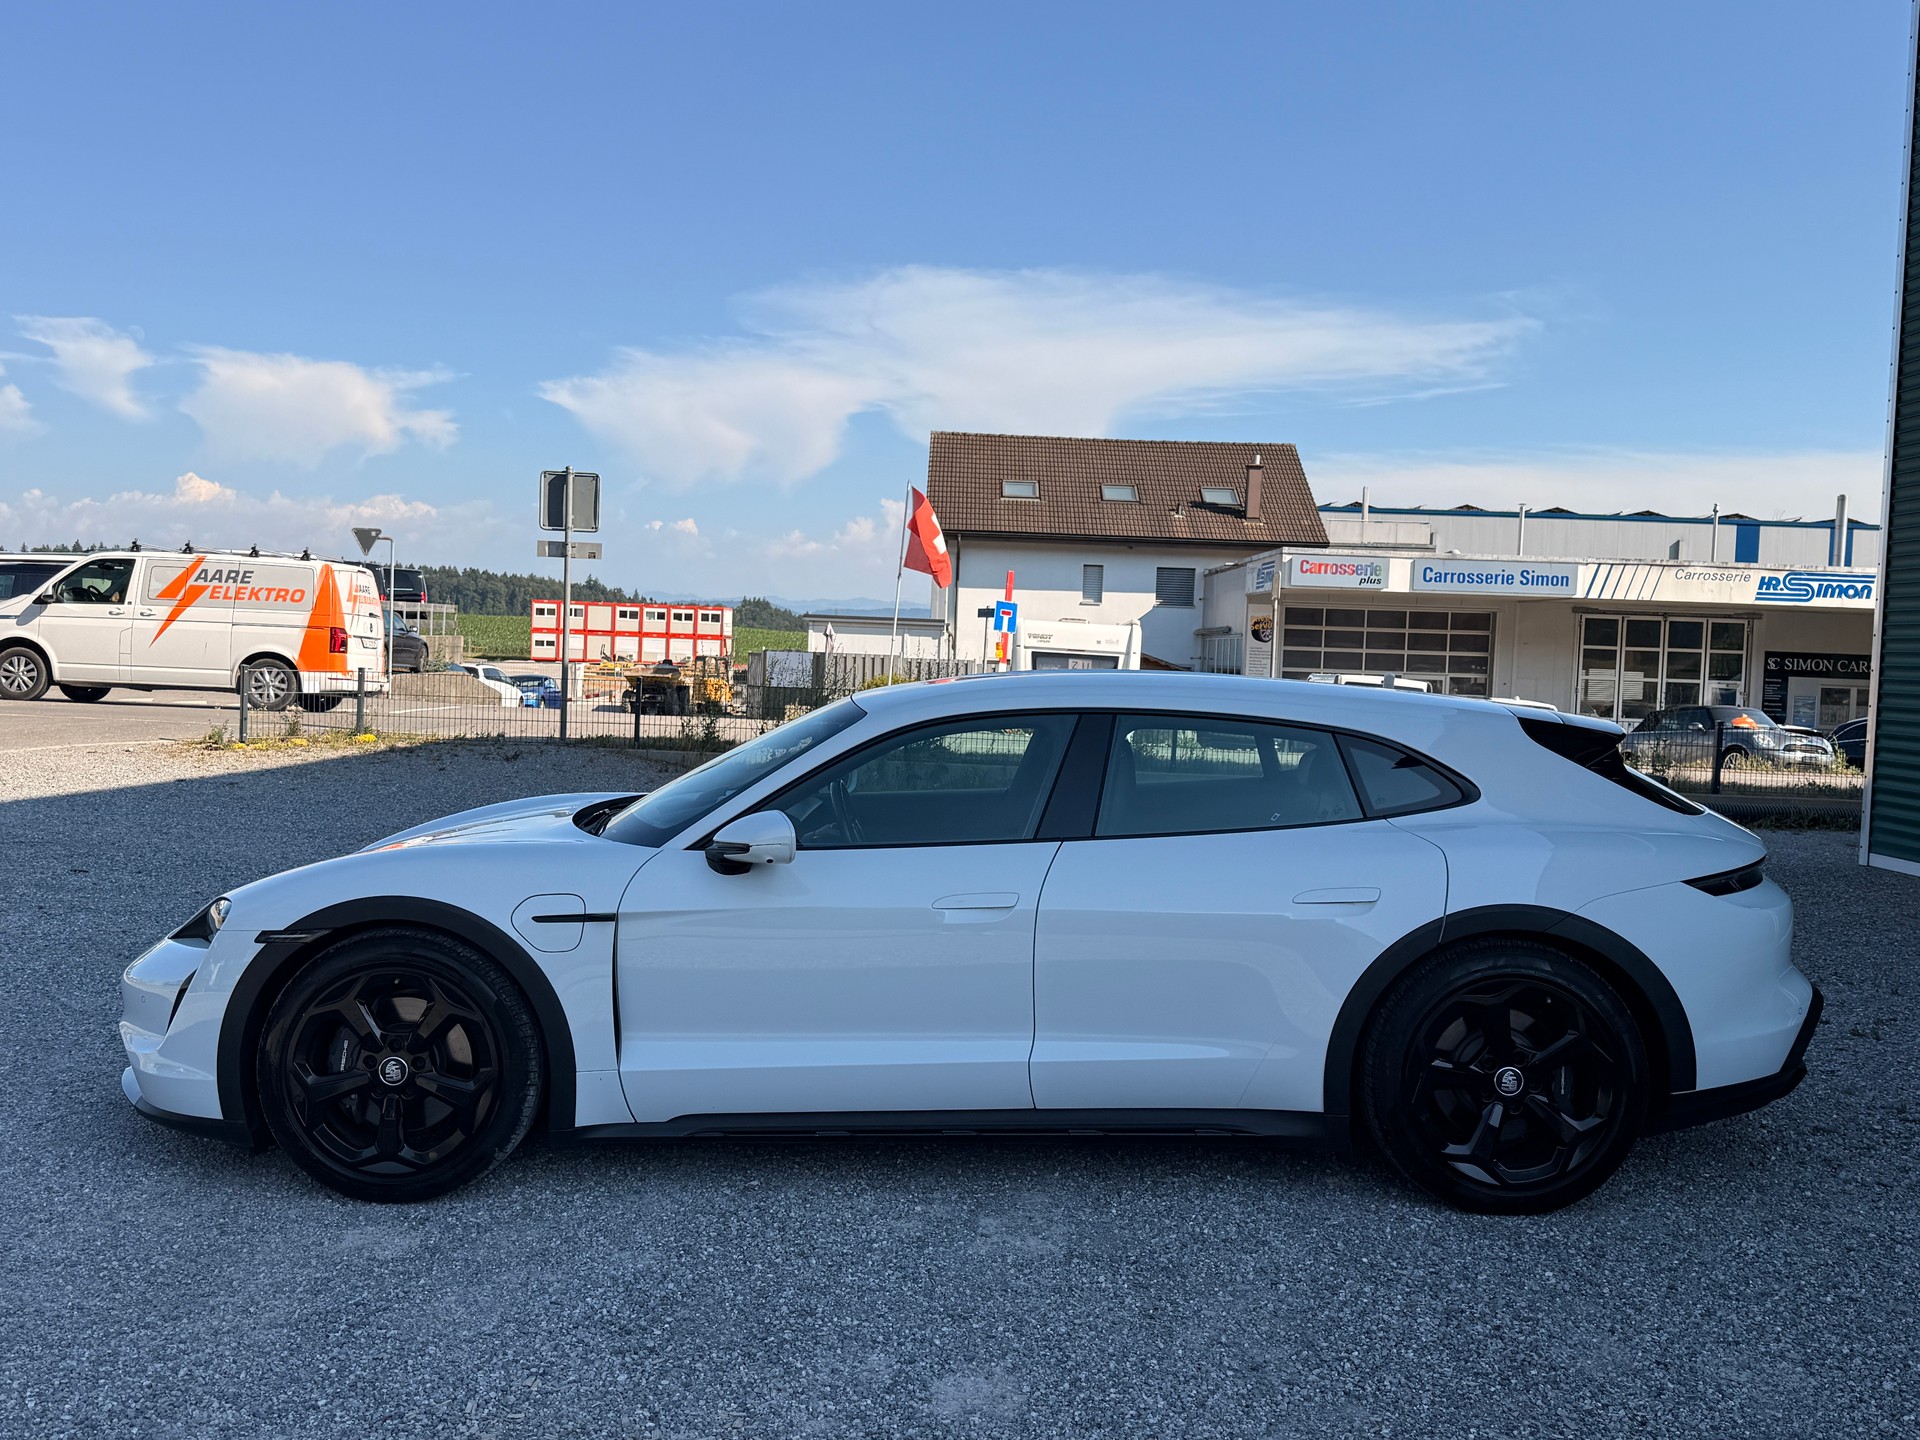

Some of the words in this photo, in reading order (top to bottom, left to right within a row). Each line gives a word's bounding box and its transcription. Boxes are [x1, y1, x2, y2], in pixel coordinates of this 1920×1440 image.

[1299, 559, 1383, 577] Carrosserie
[1675, 568, 1751, 583] Carrosserie
[194, 568, 254, 584] AARE
[1358, 575, 1382, 586] plus
[1422, 566, 1515, 586] Carrosserie
[1519, 569, 1570, 588] Simon
[209, 585, 306, 603] ELEKTRO
[359, 584, 371, 595] AARE
[1784, 658, 1834, 671] SIMON
[1837, 660, 1872, 673] CAR
